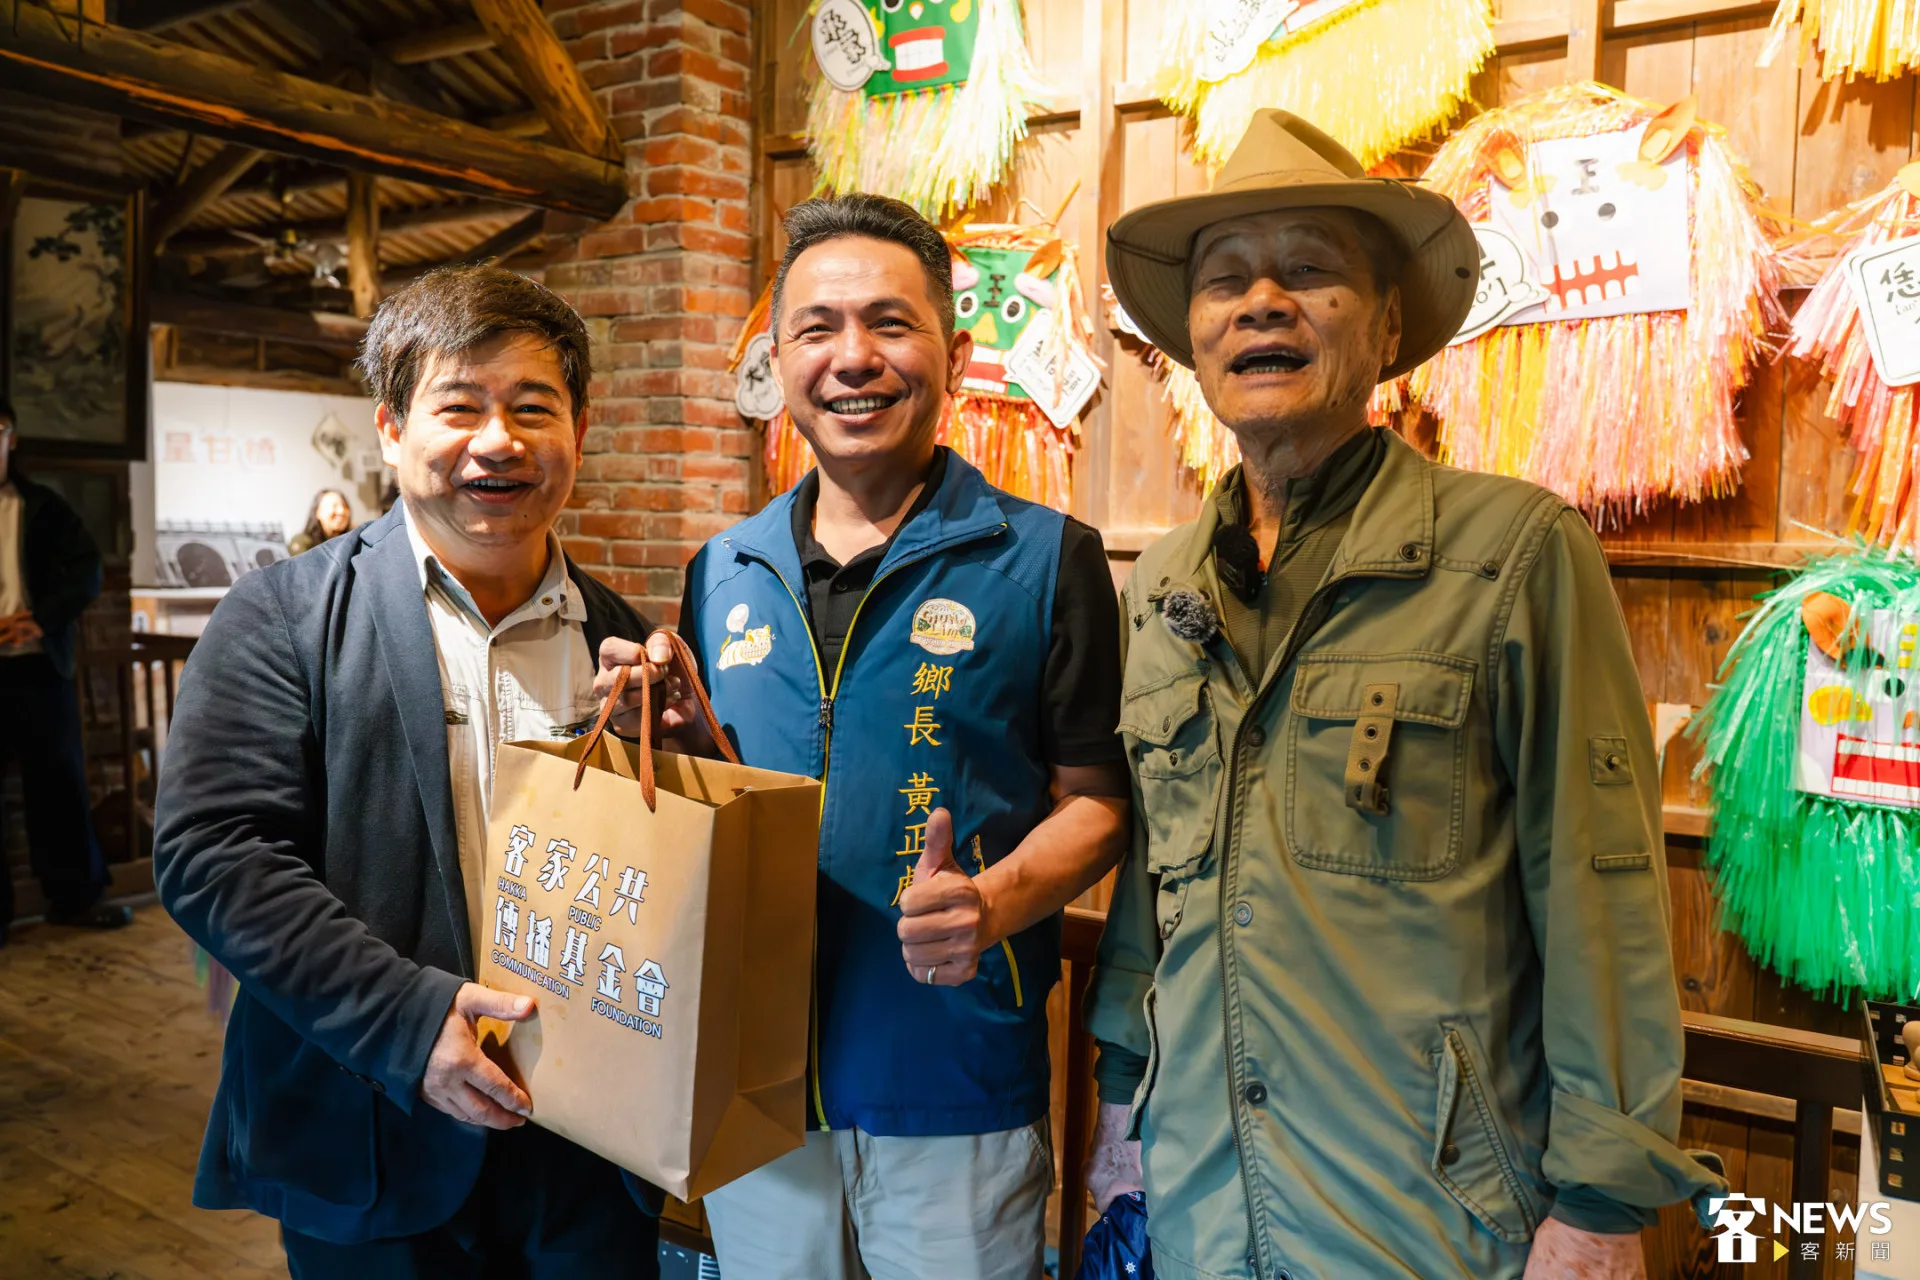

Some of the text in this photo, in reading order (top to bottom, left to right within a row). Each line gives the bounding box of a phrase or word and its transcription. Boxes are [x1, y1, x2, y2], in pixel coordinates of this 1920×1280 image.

[904, 662, 953, 746] 鄉長
[498, 877, 602, 931] HAKKA PUBLIC
[505, 825, 649, 925] 客家公共
[491, 950, 662, 1038] COMMUNICATION FOUNDATION
[494, 896, 670, 1017] 傳播基金會
